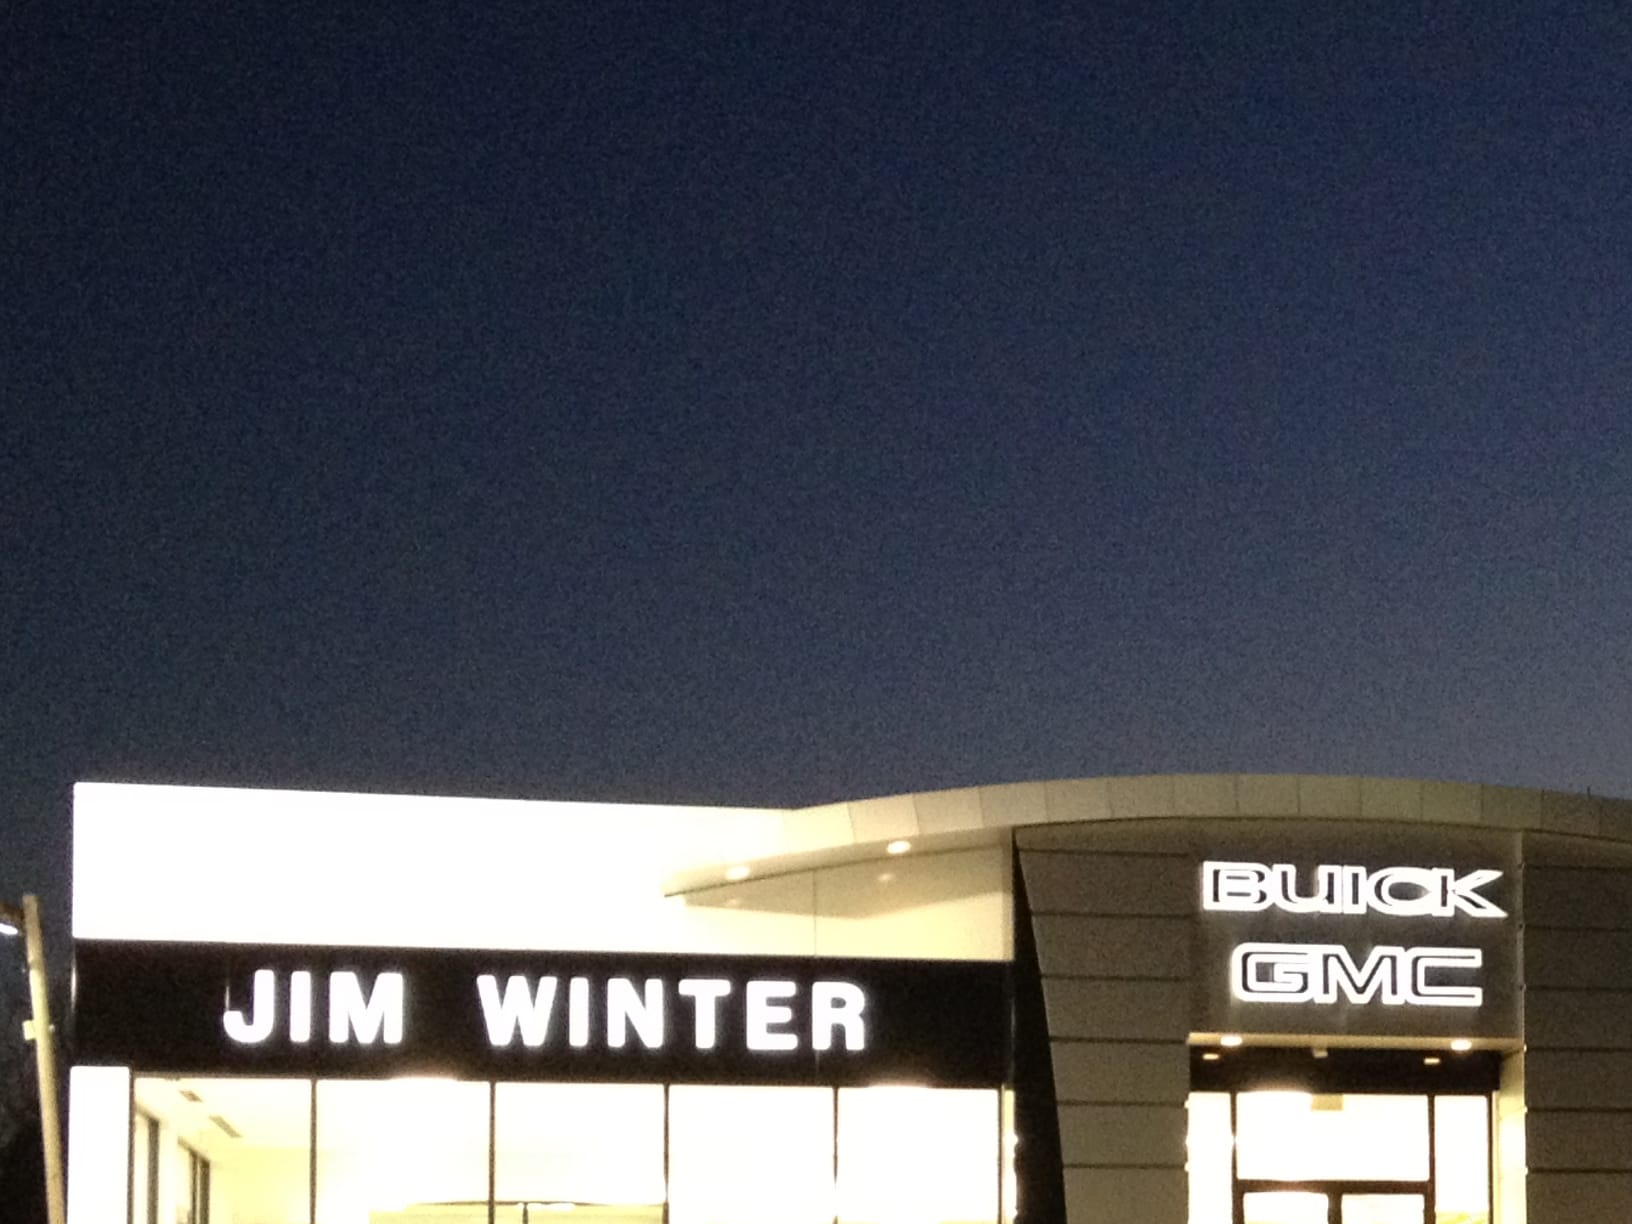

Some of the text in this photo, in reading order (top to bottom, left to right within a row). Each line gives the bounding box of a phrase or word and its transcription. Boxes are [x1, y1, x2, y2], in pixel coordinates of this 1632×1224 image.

[1202, 861, 1508, 918] BUICK
[1231, 942, 1483, 1007] GMC
[223, 969, 866, 1051] JIM WINTER
